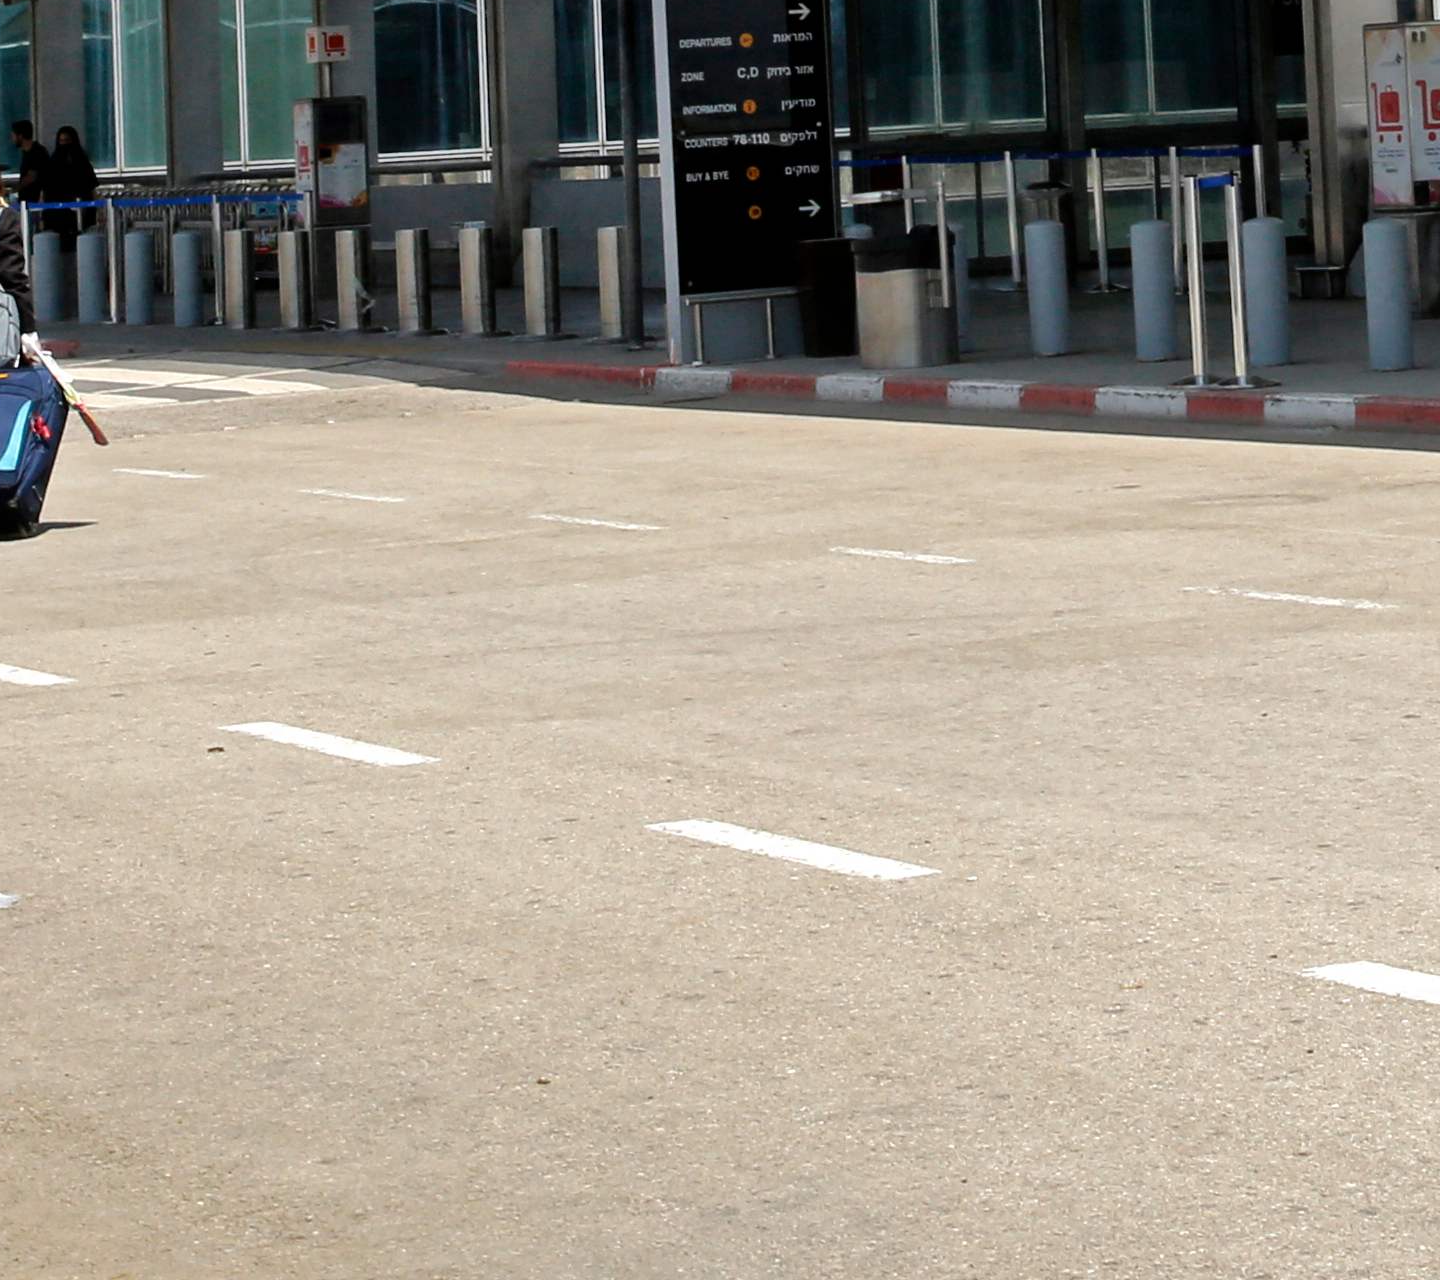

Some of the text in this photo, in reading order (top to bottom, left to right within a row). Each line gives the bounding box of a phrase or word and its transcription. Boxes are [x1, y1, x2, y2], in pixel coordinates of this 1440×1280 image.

[679, 36, 732, 48] DEPARTURES
[773, 31, 813, 43] המראות
[681, 67, 759, 83] ZONE C,D
[766, 66, 791, 80] בידוק
[682, 103, 737, 115] INFORMATION
[781, 98, 816, 112] מודיעין
[684, 137, 729, 149] COUNTERS
[779, 129, 817, 146] דלפקים
[785, 164, 820, 177] שחקים
[686, 172, 702, 183] BUY
[713, 171, 729, 181] BYE
